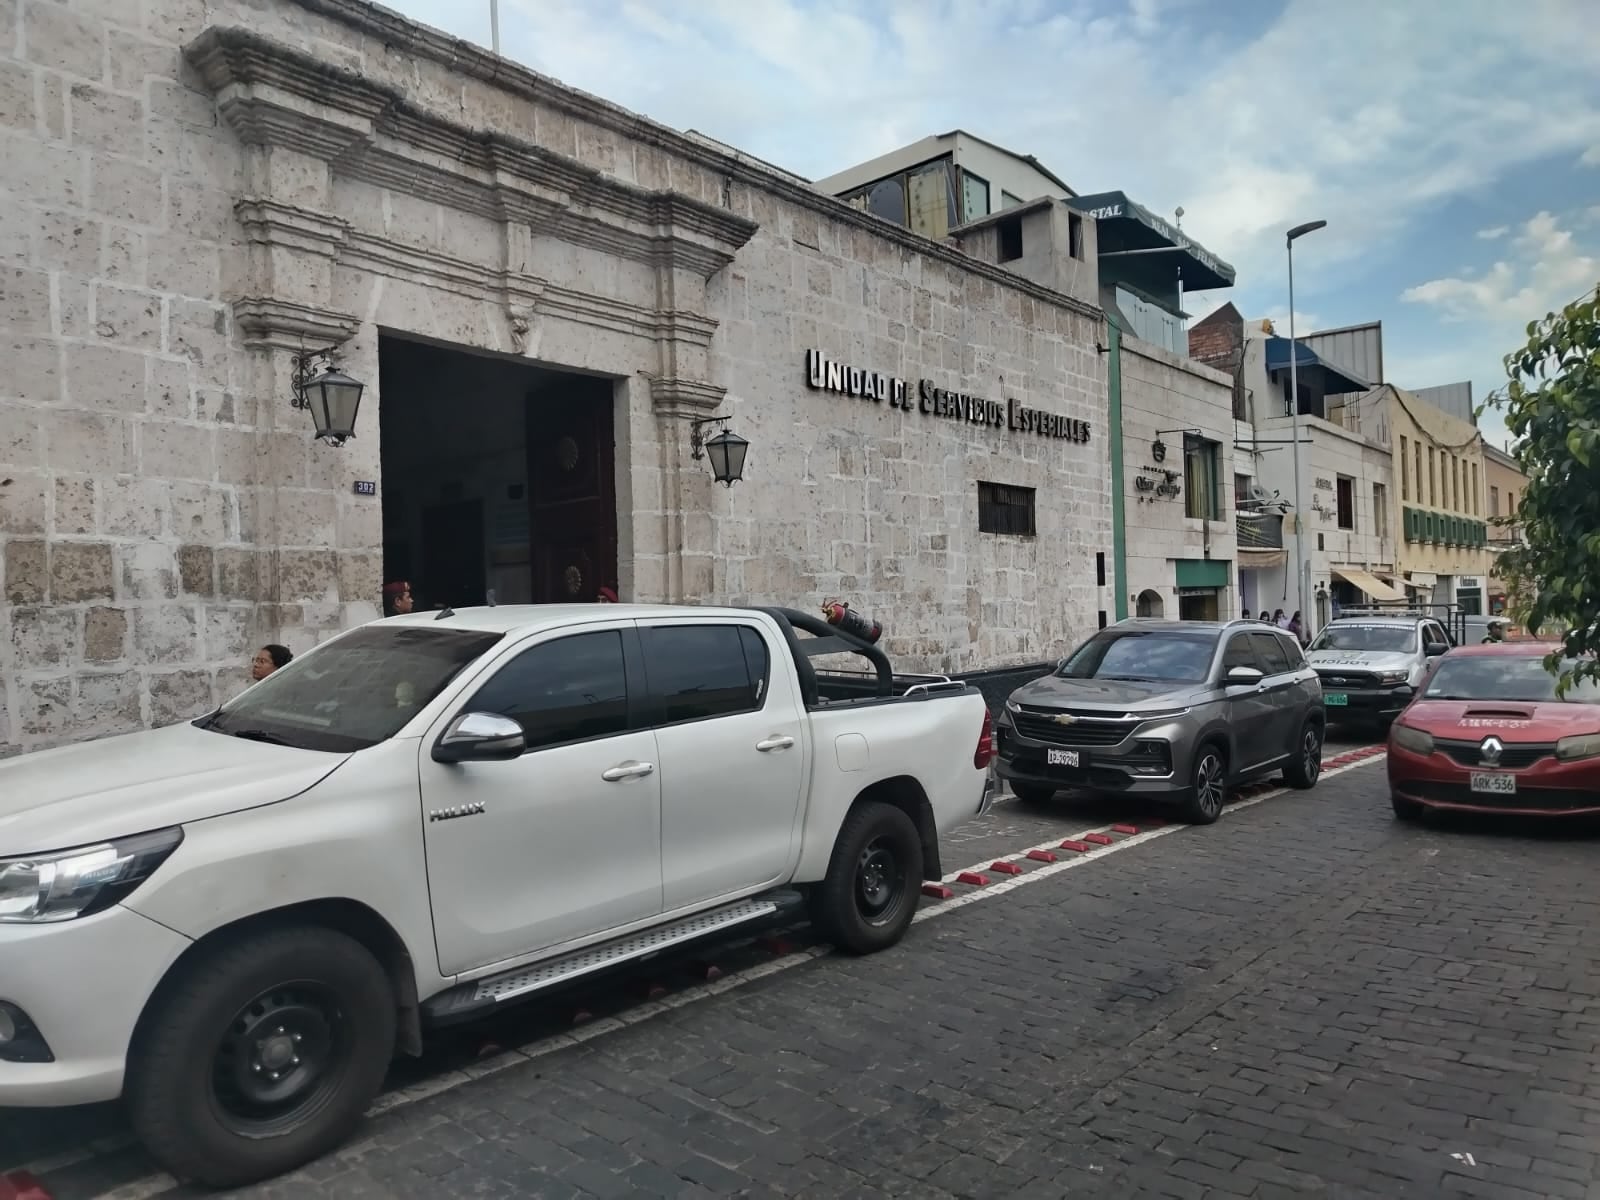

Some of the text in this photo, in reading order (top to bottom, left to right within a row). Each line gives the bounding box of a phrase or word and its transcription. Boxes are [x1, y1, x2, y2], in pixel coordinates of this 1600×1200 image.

[358, 482, 374, 492] 302
[1473, 777, 1513, 791] ARK-536
[430, 800, 485, 823] HILUX
